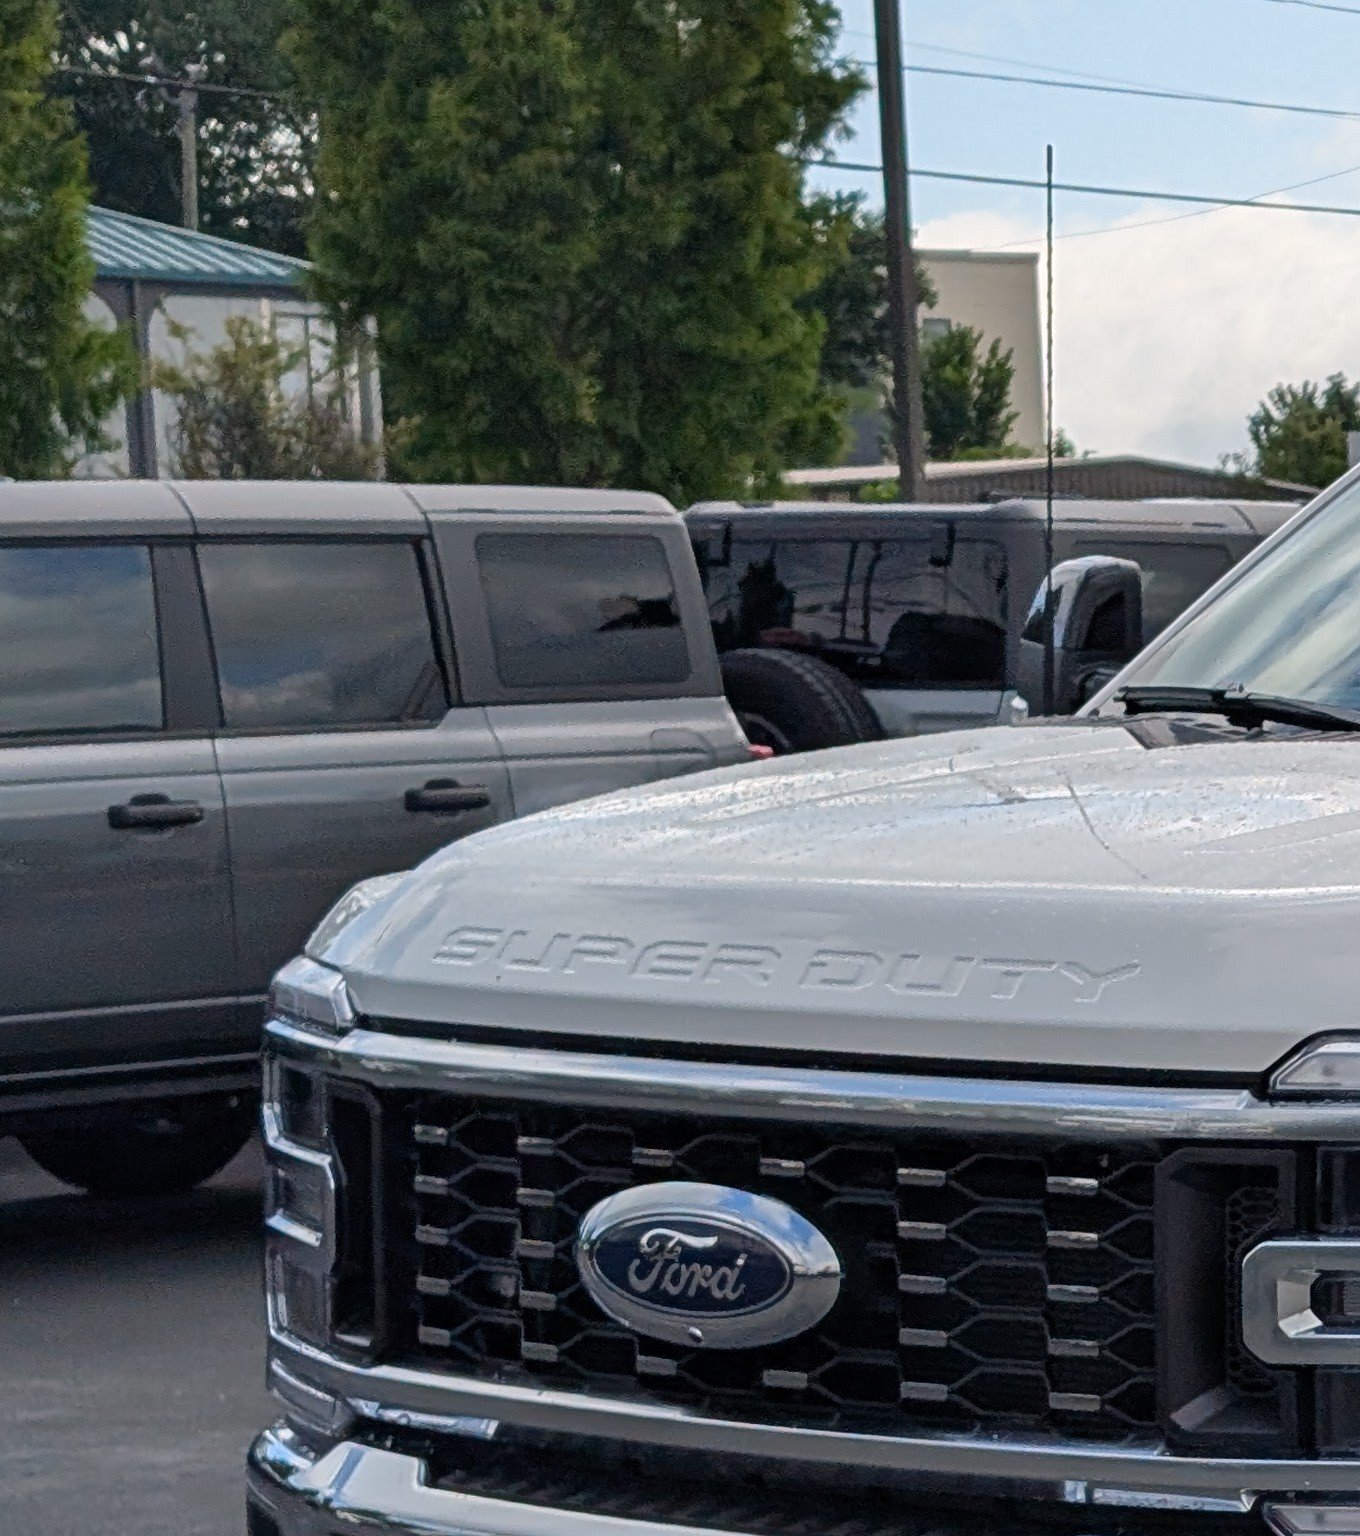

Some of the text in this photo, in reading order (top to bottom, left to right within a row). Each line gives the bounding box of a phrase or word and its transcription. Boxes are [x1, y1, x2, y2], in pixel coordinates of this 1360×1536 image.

[432, 924, 1144, 1003] SUPER DUTY
[628, 1227, 748, 1301] Ford
